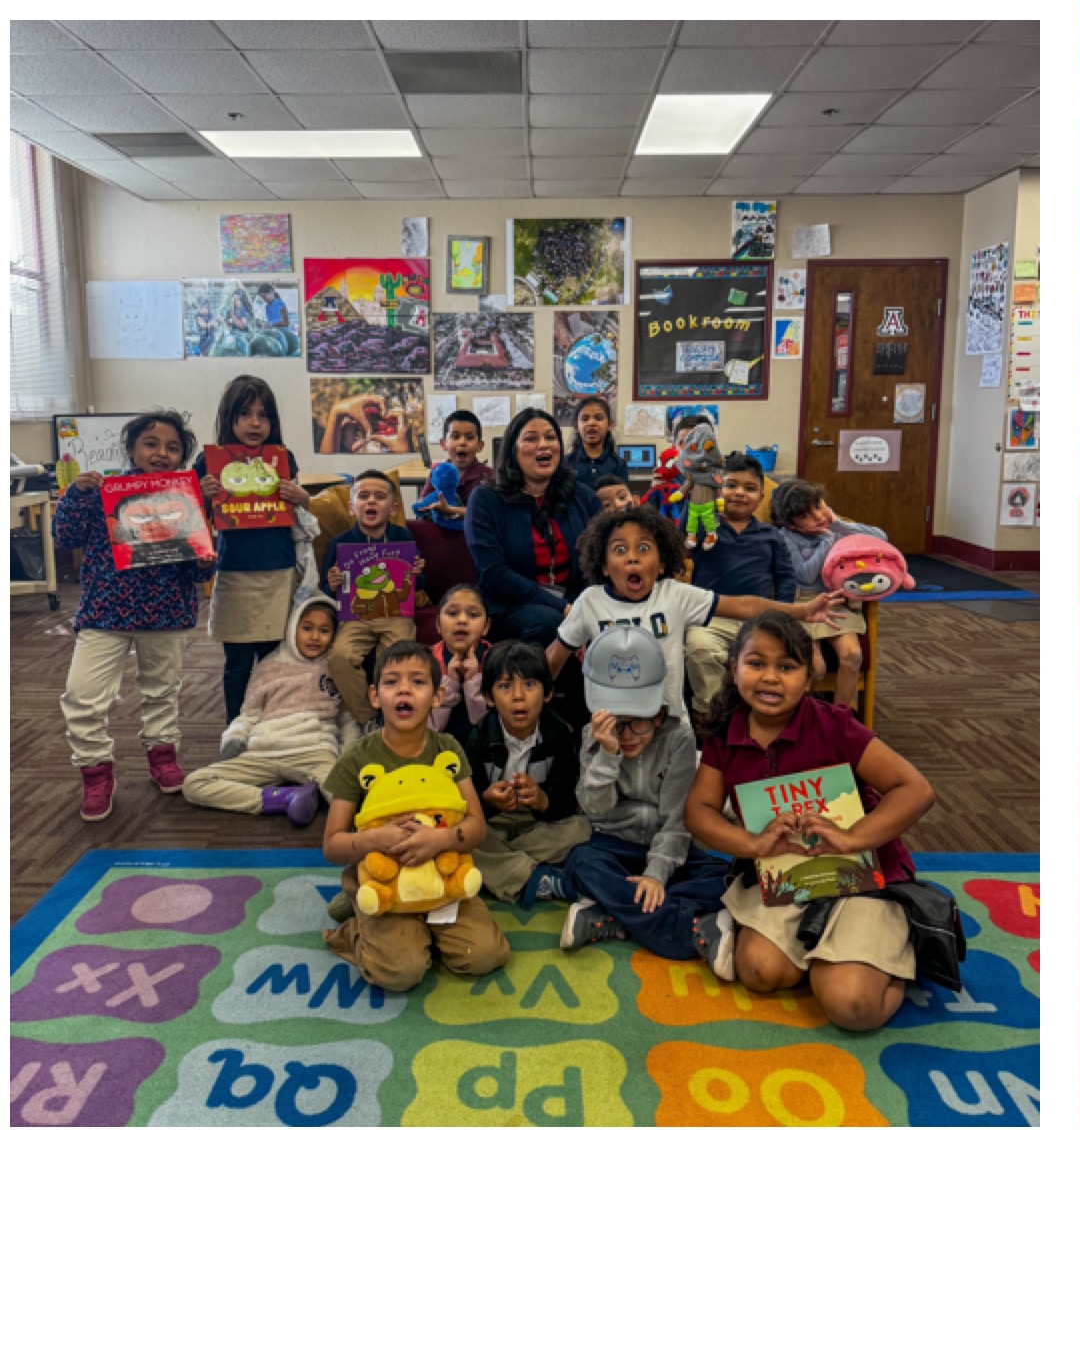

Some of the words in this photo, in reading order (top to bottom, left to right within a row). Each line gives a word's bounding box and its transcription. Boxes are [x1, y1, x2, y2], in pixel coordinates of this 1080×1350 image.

[104, 479, 148, 493] GRUMPY
[151, 476, 193, 489] MONKEY
[222, 502, 250, 513] SOUR
[254, 501, 286, 511] APPLE
[764, 776, 823, 805] TINY
